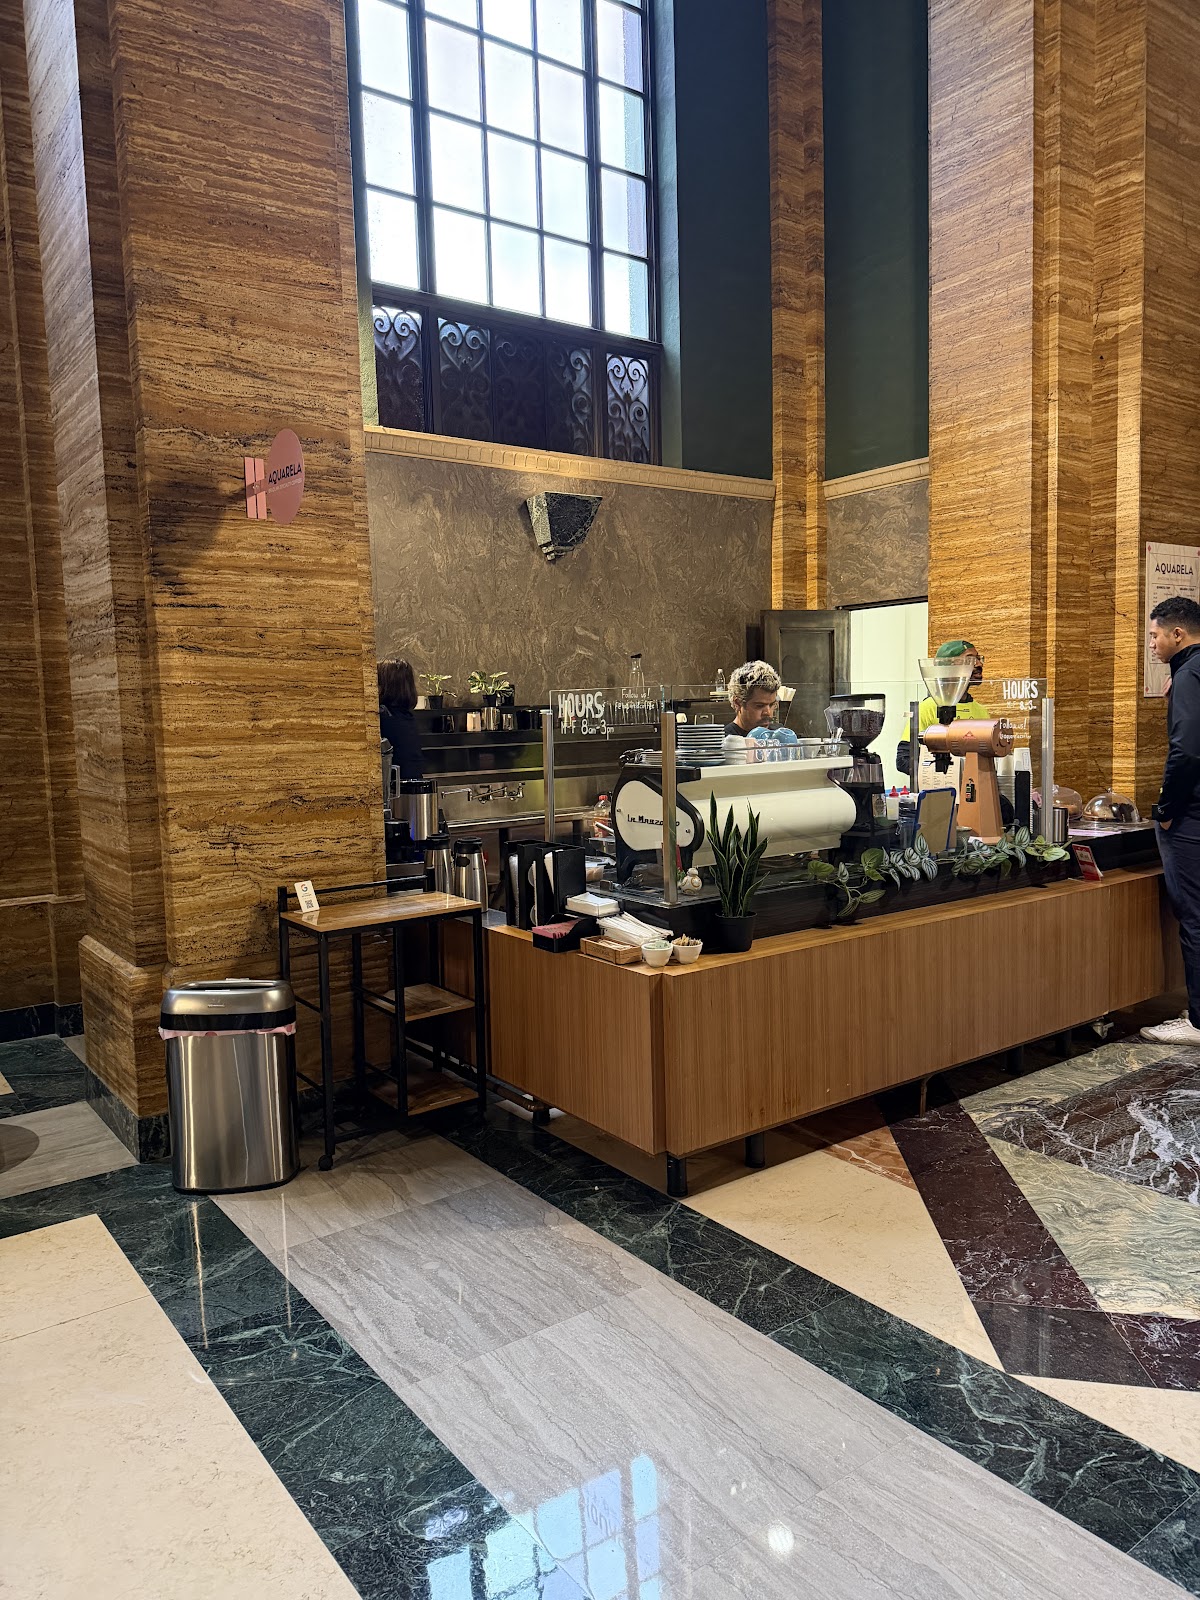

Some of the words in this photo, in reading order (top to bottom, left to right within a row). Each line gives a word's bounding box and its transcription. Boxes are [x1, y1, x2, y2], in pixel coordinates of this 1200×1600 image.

[267, 463, 303, 485] AQUARELA
[1155, 562, 1194, 576] AQUARELA
[621, 688, 639, 699] Follow
[1003, 680, 1039, 699] HOURS
[557, 691, 604, 719] HOURS
[581, 718, 615, 741] 8am-3pm
[638, 815, 680, 827] Marzoo
